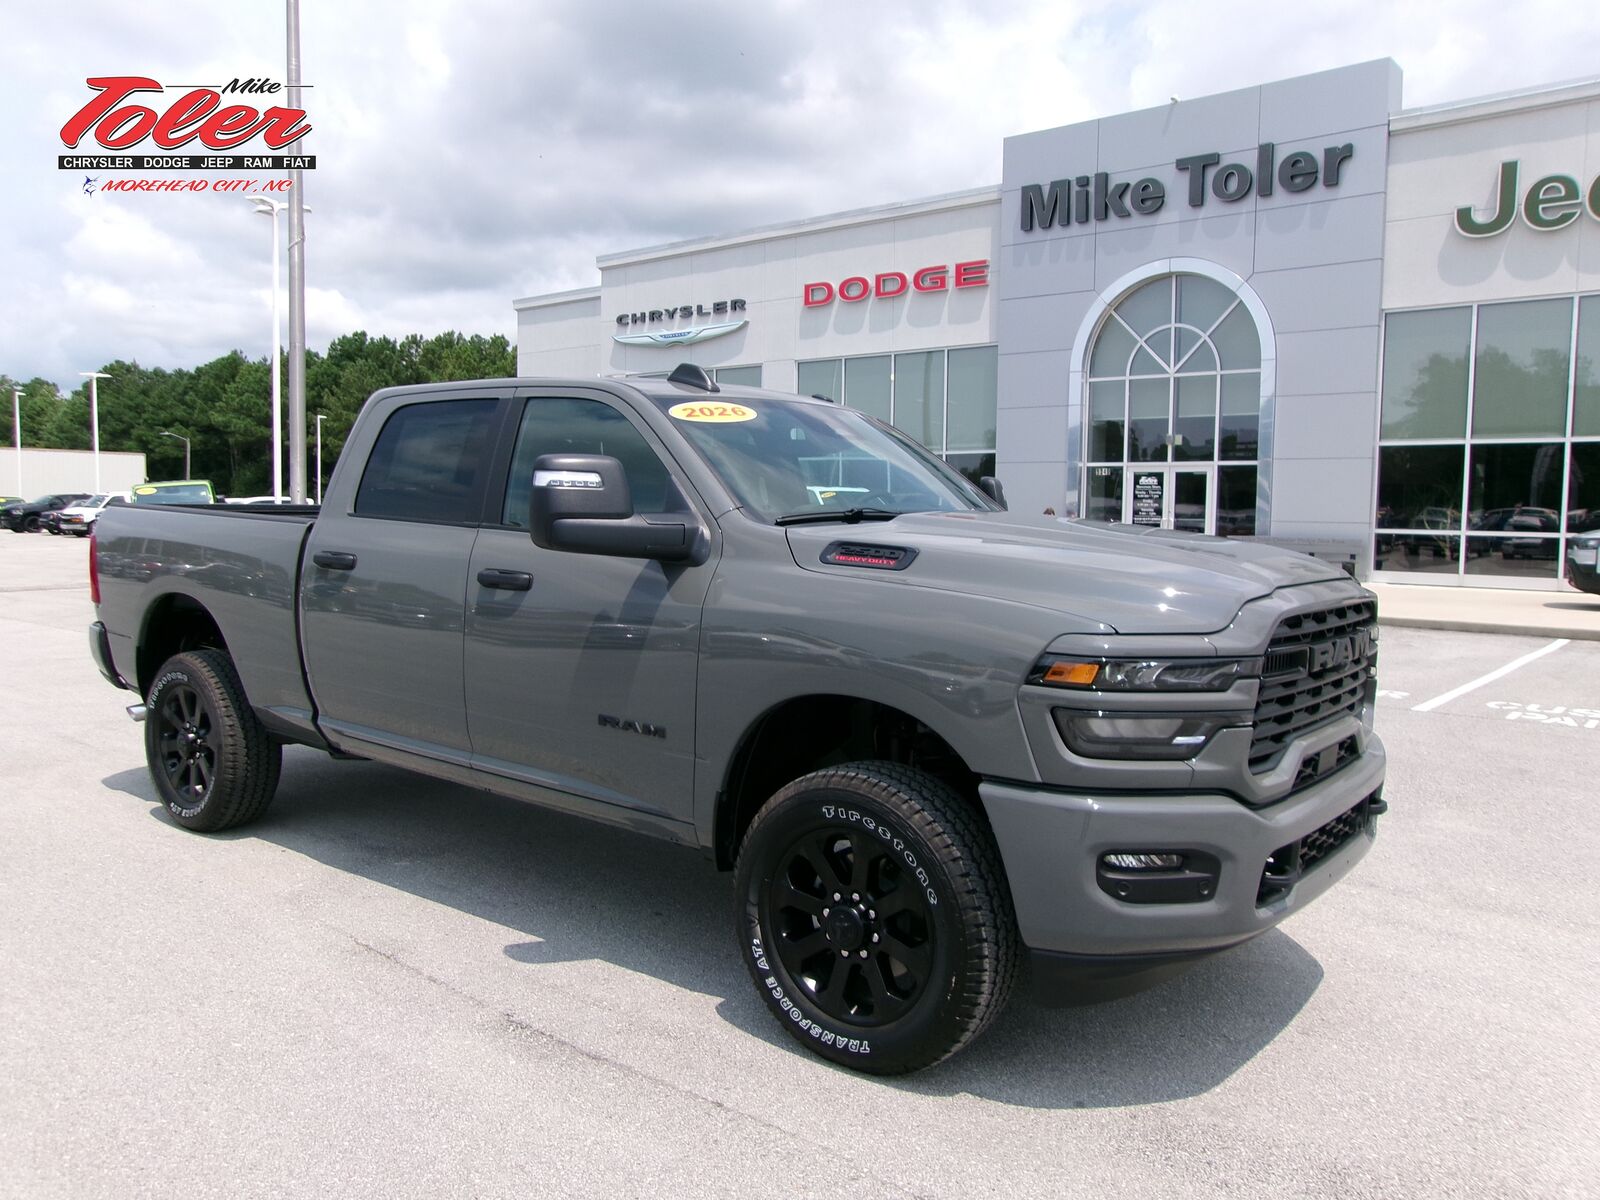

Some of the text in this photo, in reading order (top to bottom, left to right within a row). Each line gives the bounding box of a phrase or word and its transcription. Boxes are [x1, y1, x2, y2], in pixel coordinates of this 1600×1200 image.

[1020, 142, 1354, 232] Mike Toler
[1454, 160, 1600, 238] Je
[803, 260, 989, 308] DODGE
[615, 299, 747, 327] CHRYSLER
[682, 406, 747, 418] 2026
[835, 555, 897, 566] HEAVY DUTY
[1309, 630, 1373, 673] RAM
[598, 713, 667, 739] RAM
[822, 805, 938, 905] Firestone
[765, 976, 870, 1053] TRANSFORCE
